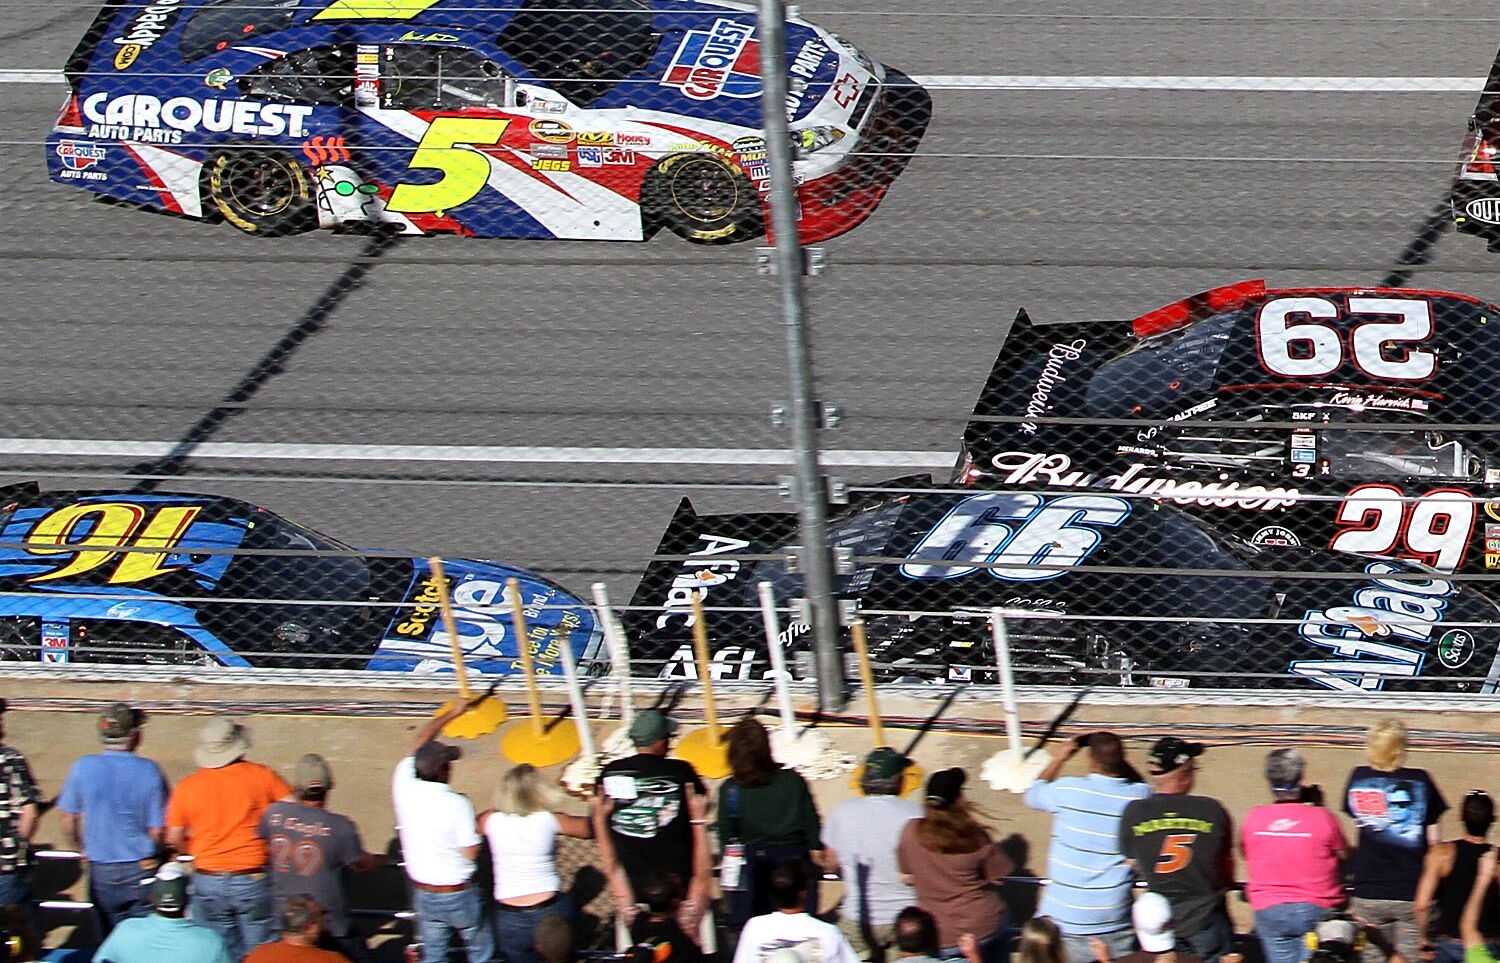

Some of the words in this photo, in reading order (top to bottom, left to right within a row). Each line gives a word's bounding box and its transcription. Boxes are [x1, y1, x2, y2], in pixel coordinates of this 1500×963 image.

[685, 20, 752, 98] CARQUEST
[789, 39, 830, 79] PARTS
[83, 92, 313, 137] CARQUEST
[87, 124, 129, 140] AUTO
[133, 127, 183, 144] PARTS
[57, 146, 106, 158] CARQUEST
[603, 148, 634, 164] 3M
[60, 169, 83, 180] AUTO
[85, 171, 108, 181] PARTS
[386, 117, 512, 214] 5
[531, 159, 572, 172] JEGS
[1472, 202, 1493, 218] DU
[1257, 295, 1438, 381] 29
[1291, 412, 1316, 421] SKF
[1118, 445, 1159, 456] MENARDS
[991, 451, 1300, 511] Budweiser
[1292, 464, 1311, 478] 3
[1330, 484, 1477, 576] 29
[44, 637, 67, 648] 3M
[1444, 632, 1467, 664] Scotts
[1154, 833, 1198, 874] 5
